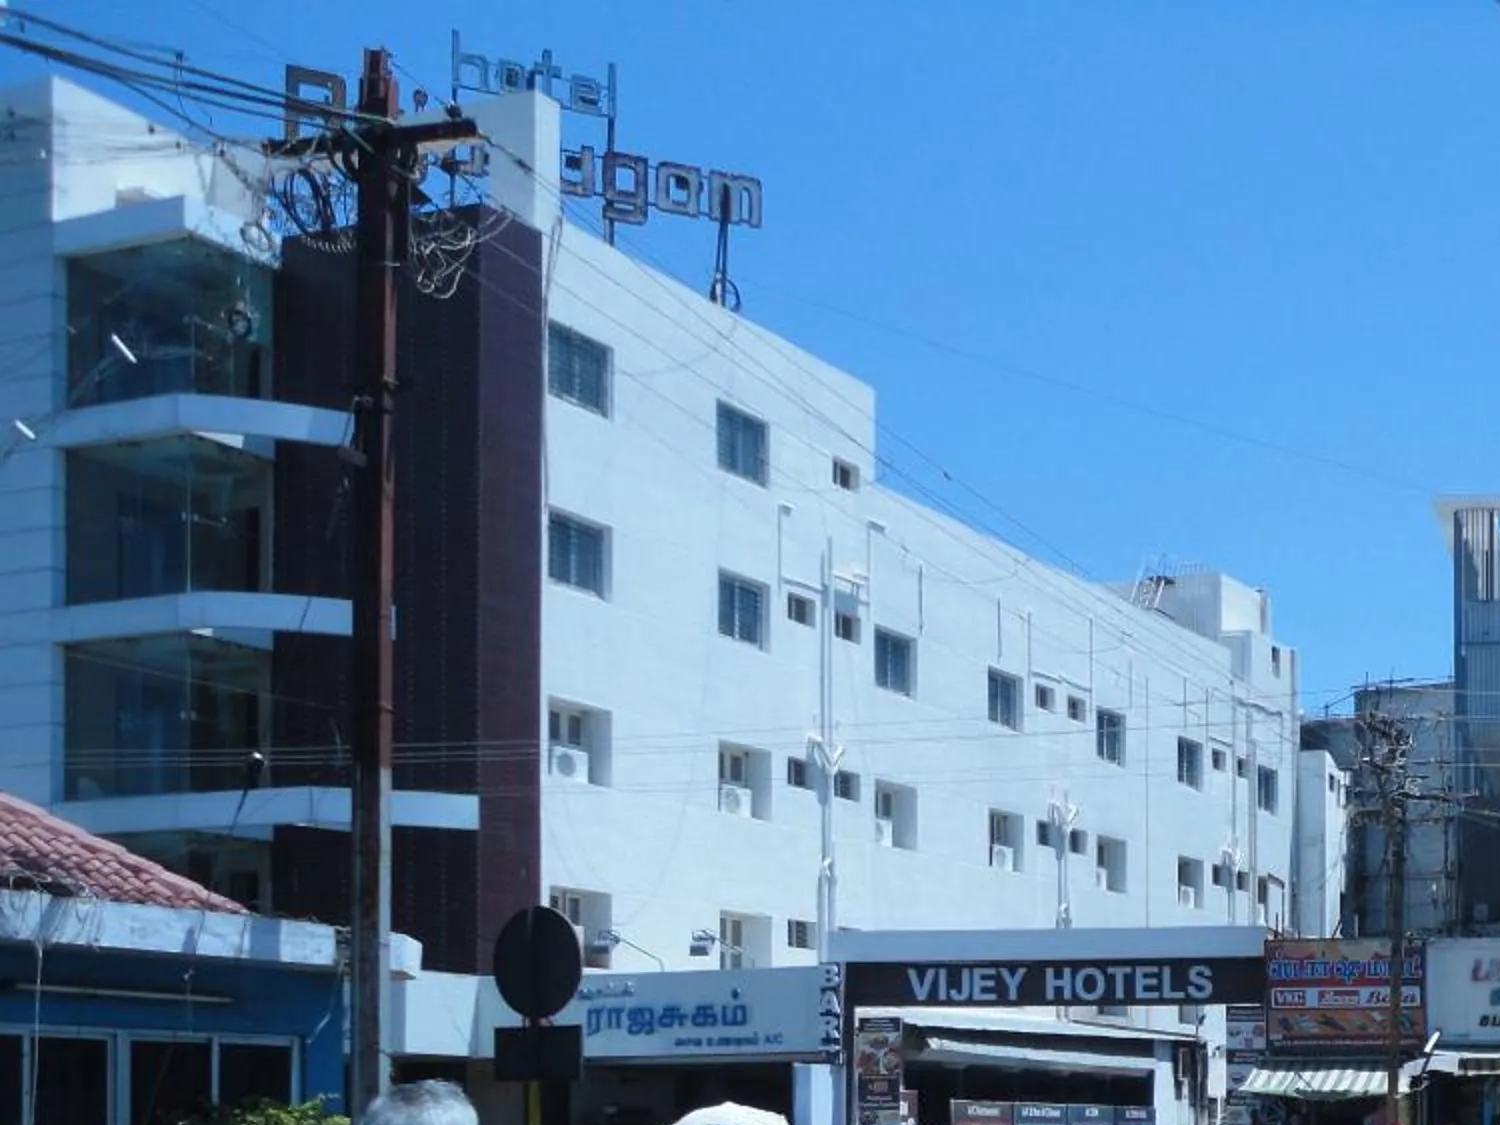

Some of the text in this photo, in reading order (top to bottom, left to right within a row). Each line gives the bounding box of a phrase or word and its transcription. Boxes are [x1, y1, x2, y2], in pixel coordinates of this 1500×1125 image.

[451, 28, 617, 117] hotel
[907, 964, 1213, 1003] VIJEY HOTELS
[587, 987, 748, 1036] ராஜசுகம்
